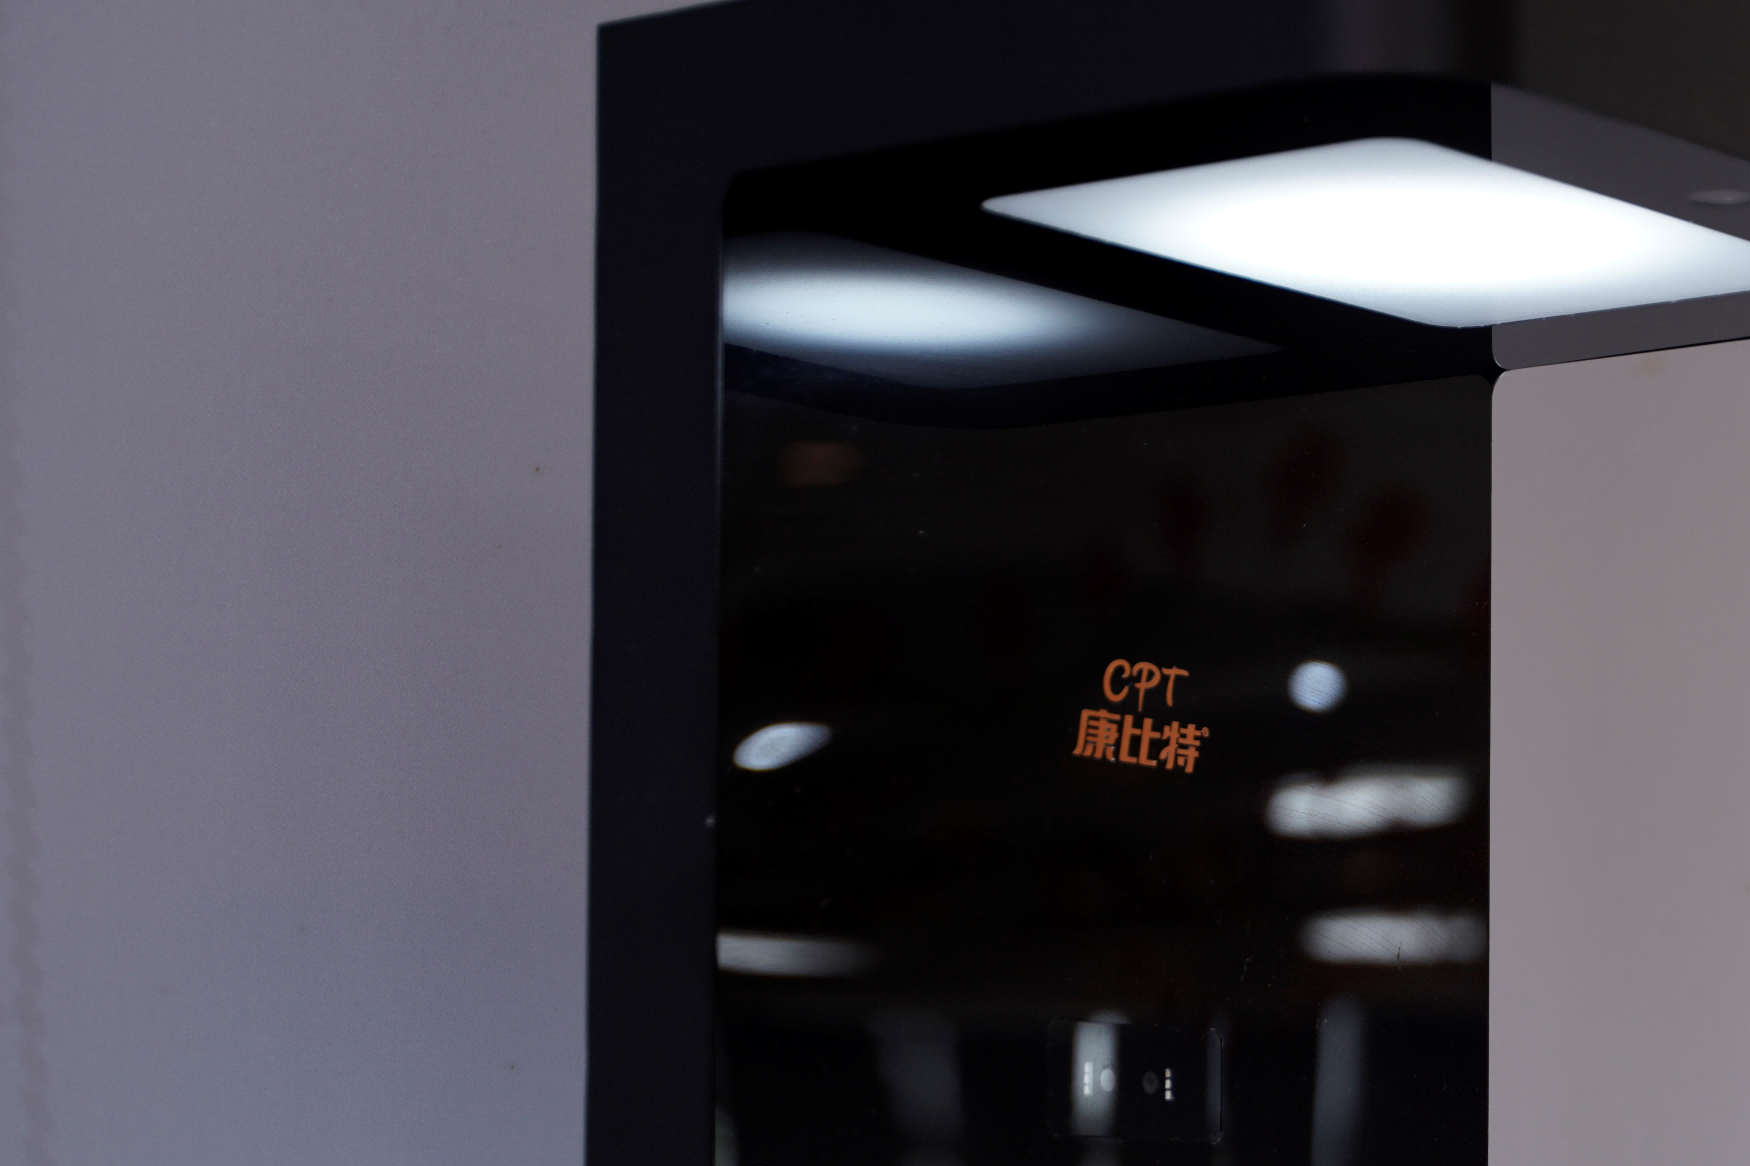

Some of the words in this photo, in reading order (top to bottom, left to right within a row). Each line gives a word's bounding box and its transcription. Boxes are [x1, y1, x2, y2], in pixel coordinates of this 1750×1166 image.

[1103, 658, 1190, 712] CPT
[1072, 708, 1204, 774] 康比特
